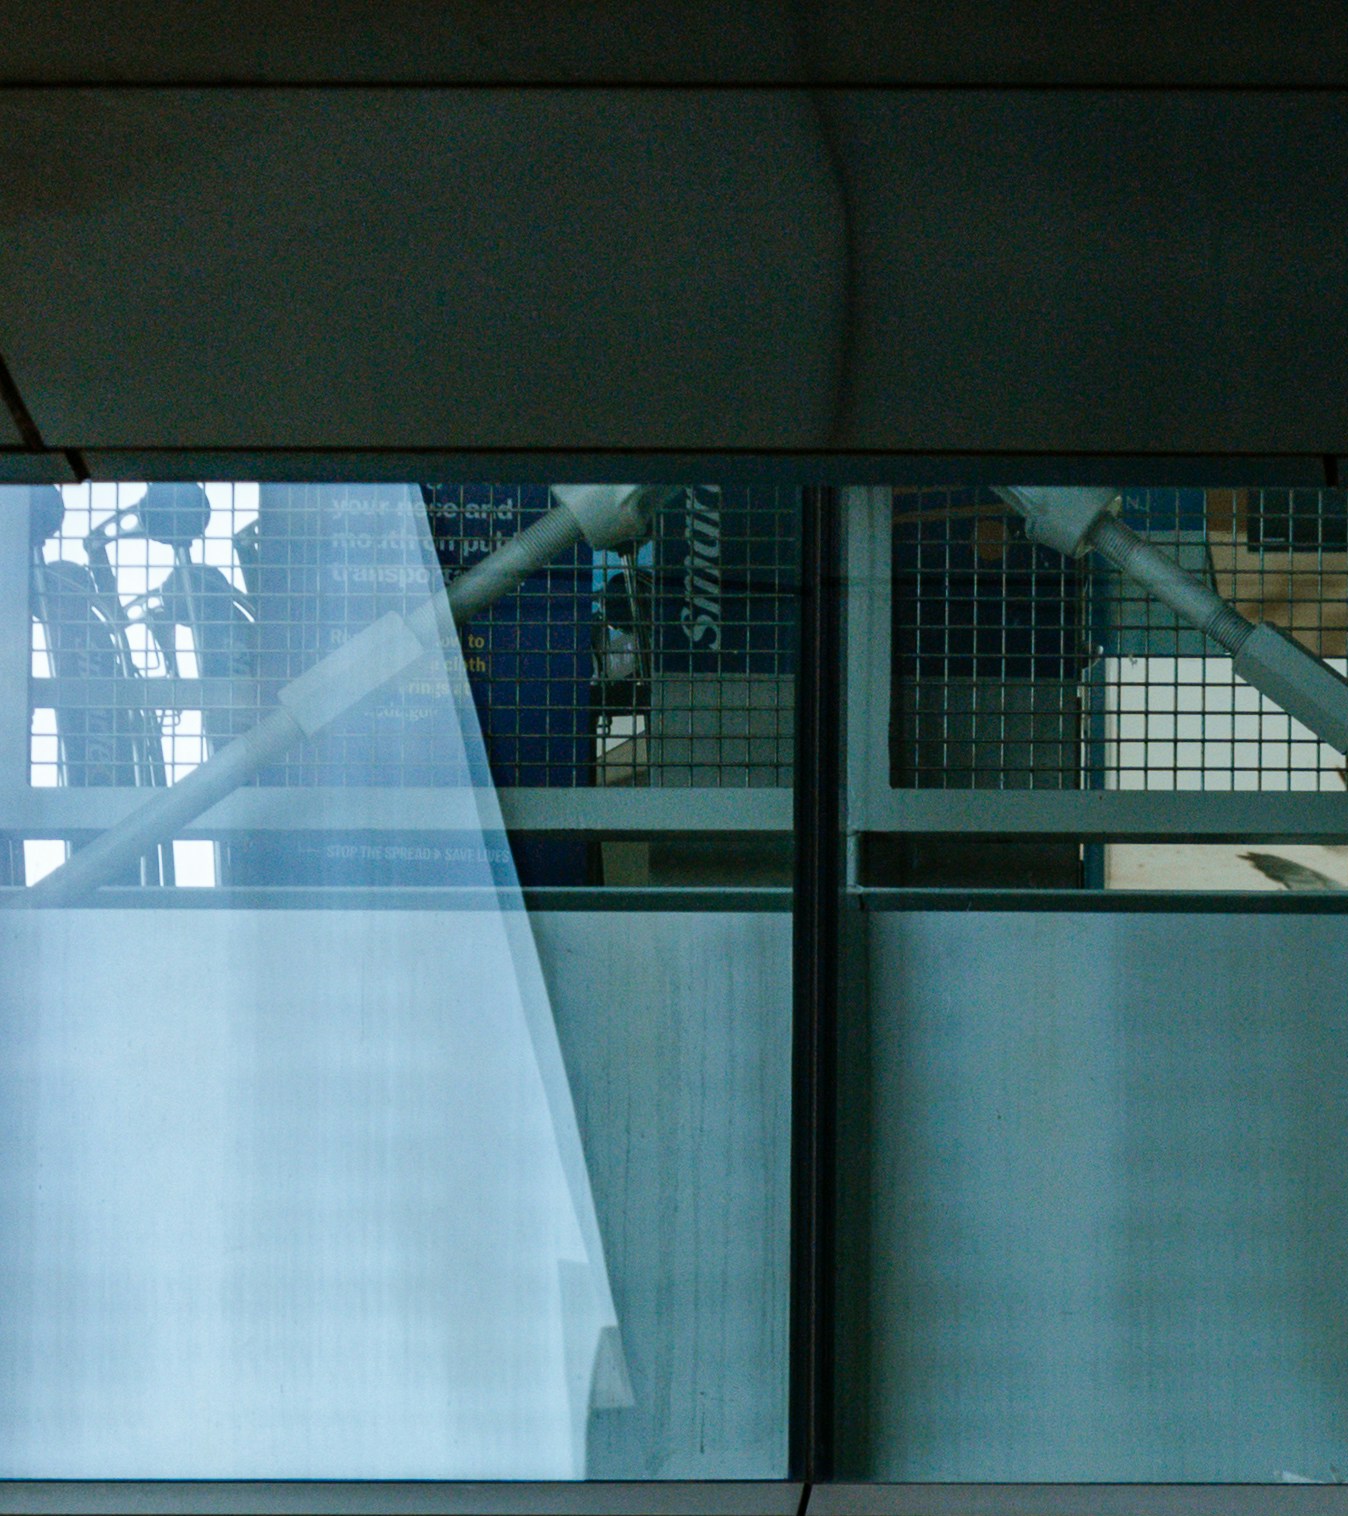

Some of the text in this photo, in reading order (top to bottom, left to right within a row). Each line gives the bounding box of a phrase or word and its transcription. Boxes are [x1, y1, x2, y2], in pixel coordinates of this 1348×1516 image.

[331, 498, 390, 520] your
[464, 497, 514, 520] and
[467, 633, 486, 649] to
[326, 845, 358, 858] STOP
[360, 846, 383, 859] THE
[384, 846, 431, 860] SPREAD
[444, 848, 475, 862] SAVE
